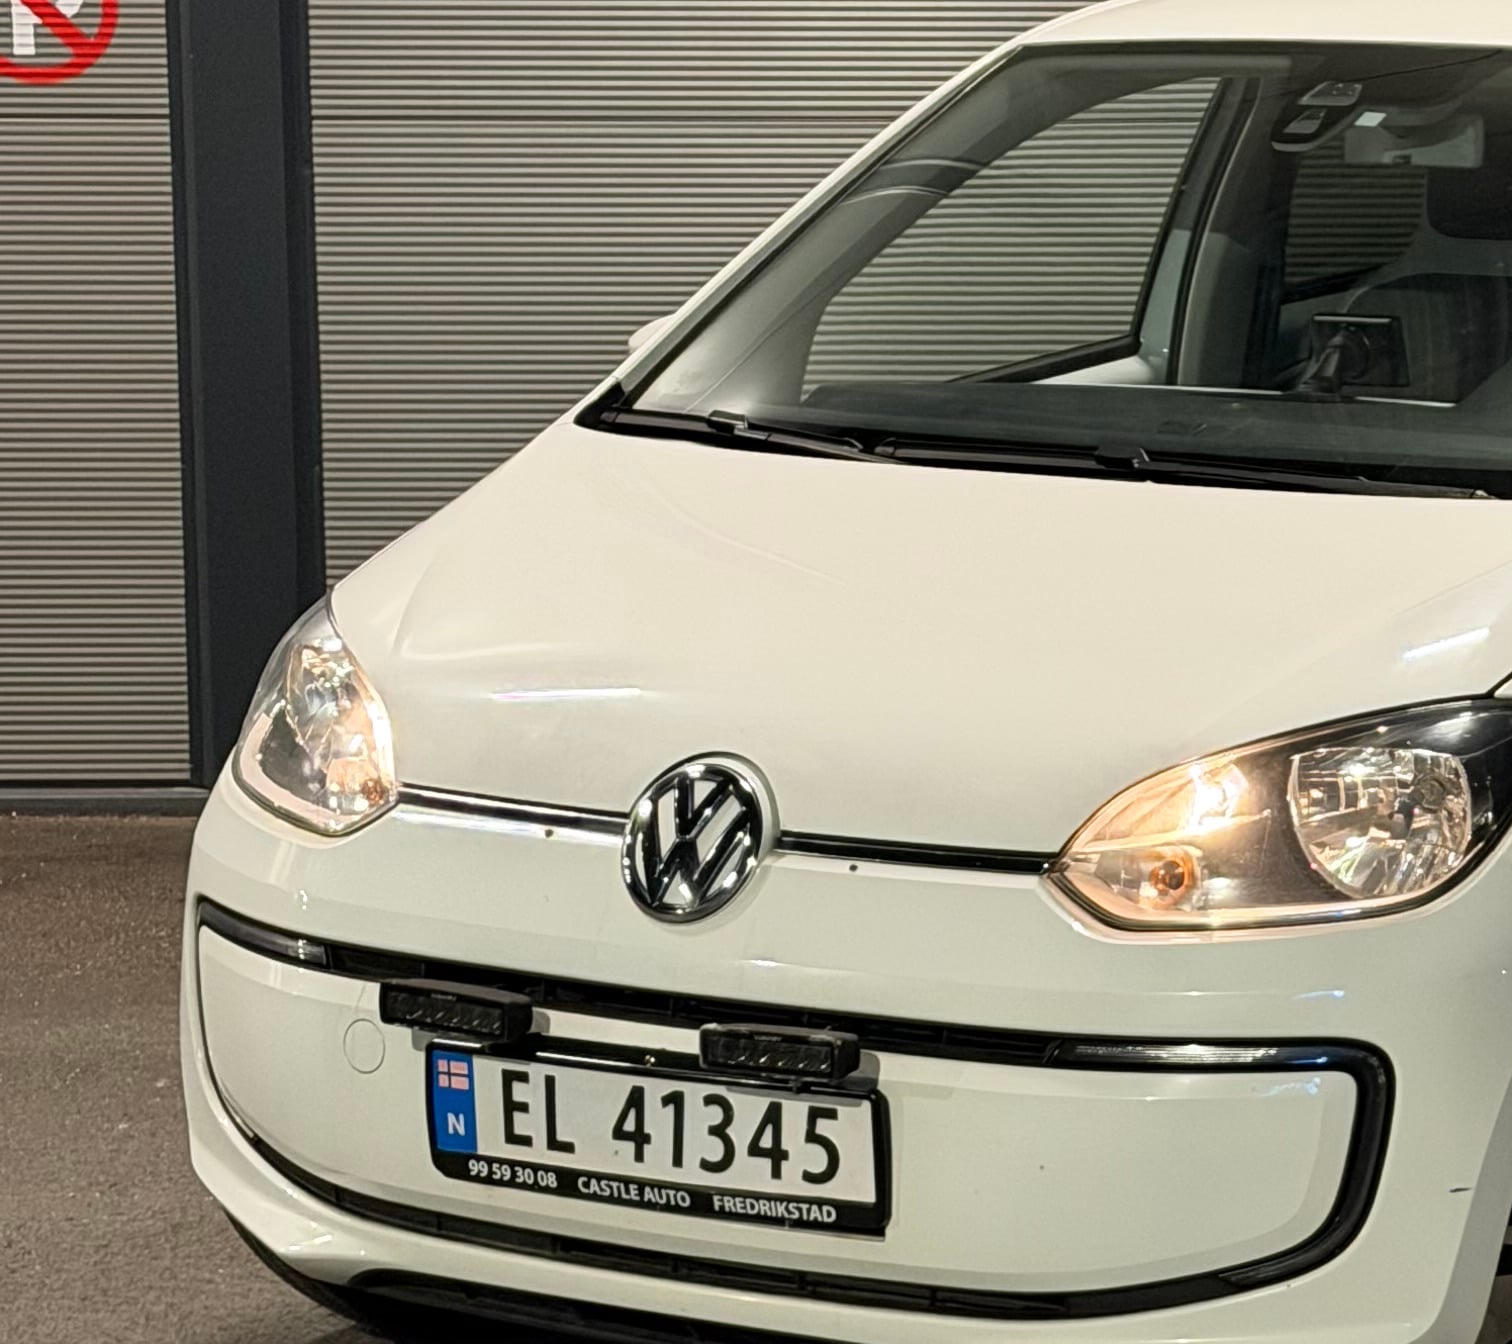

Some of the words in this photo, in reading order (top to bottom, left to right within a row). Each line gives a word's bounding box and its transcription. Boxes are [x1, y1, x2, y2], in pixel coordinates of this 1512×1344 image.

[621, 763, 764, 923] VW
[447, 1112, 466, 1136] N
[501, 1068, 576, 1154] EL
[611, 1084, 841, 1185] 41345
[468, 1159, 489, 1178] 99
[492, 1163, 512, 1182] 59
[514, 1168, 535, 1187] 30
[537, 1171, 558, 1188] 08
[577, 1176, 641, 1202] CASTLE
[643, 1189, 691, 1208] AUTO
[713, 1194, 837, 1223] FREDRIKSTAD
